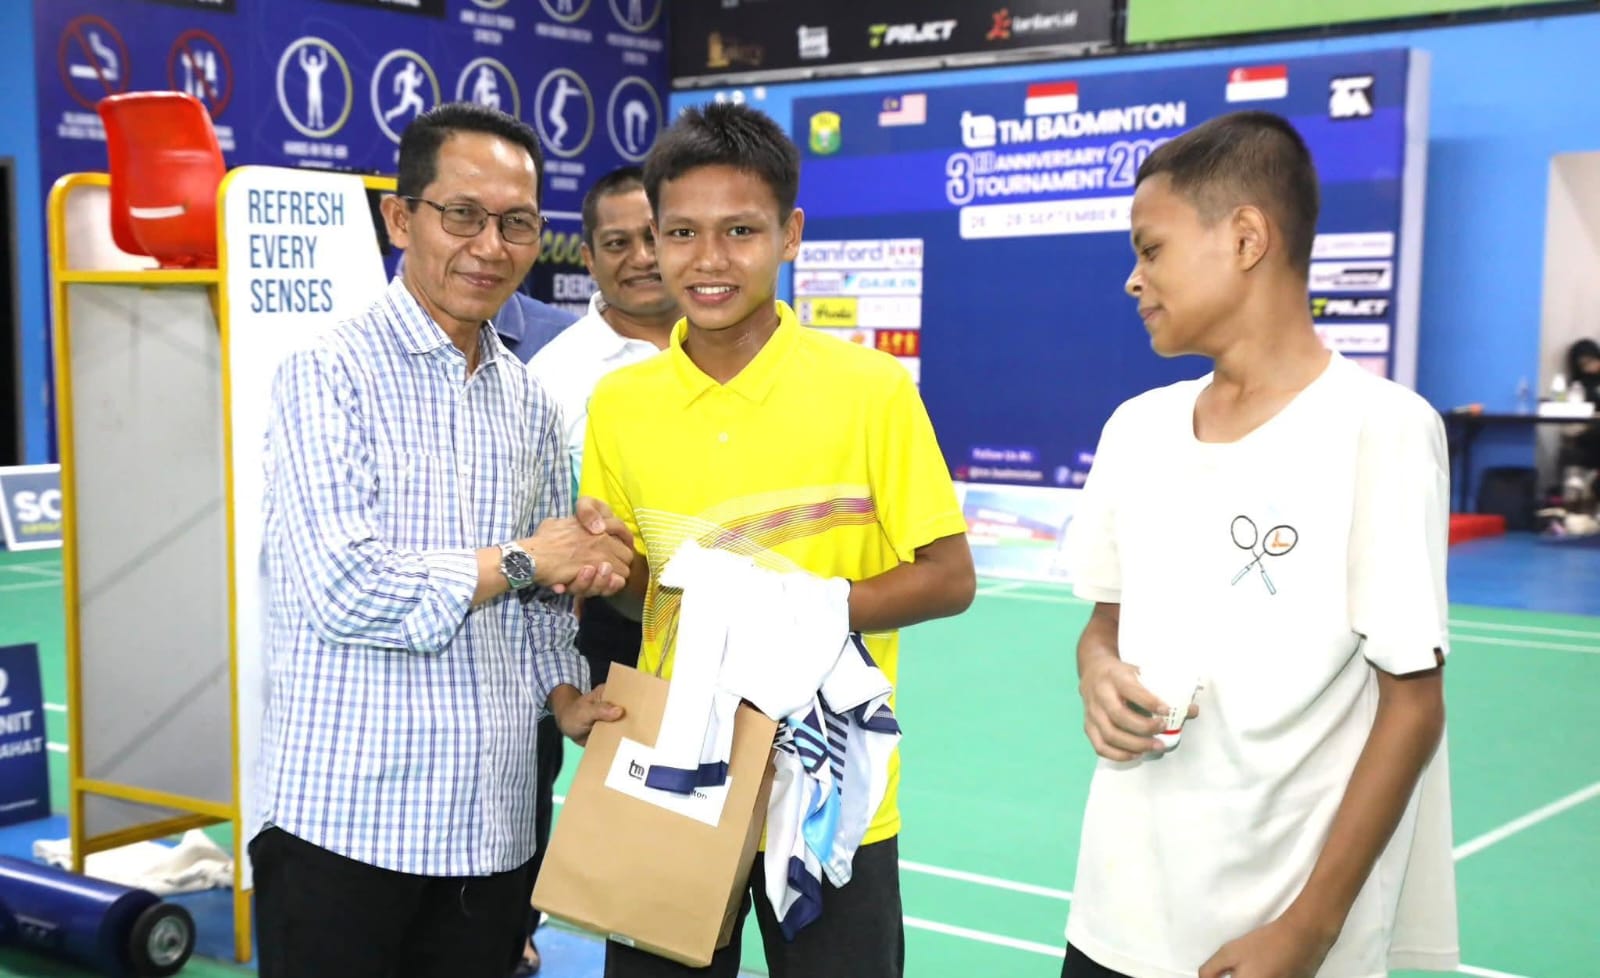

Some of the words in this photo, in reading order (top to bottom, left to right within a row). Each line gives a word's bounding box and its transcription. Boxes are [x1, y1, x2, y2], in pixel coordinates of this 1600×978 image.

[998, 117, 1034, 145] TM
[1035, 101, 1187, 141] BADMINTON
[995, 146, 1108, 173] ANNIVERSARY
[975, 166, 1108, 197] TOURNAMENT
[248, 189, 344, 226] REFRESH
[250, 234, 317, 269] EVERY
[803, 240, 883, 263] sanford
[250, 278, 333, 313] SENSES
